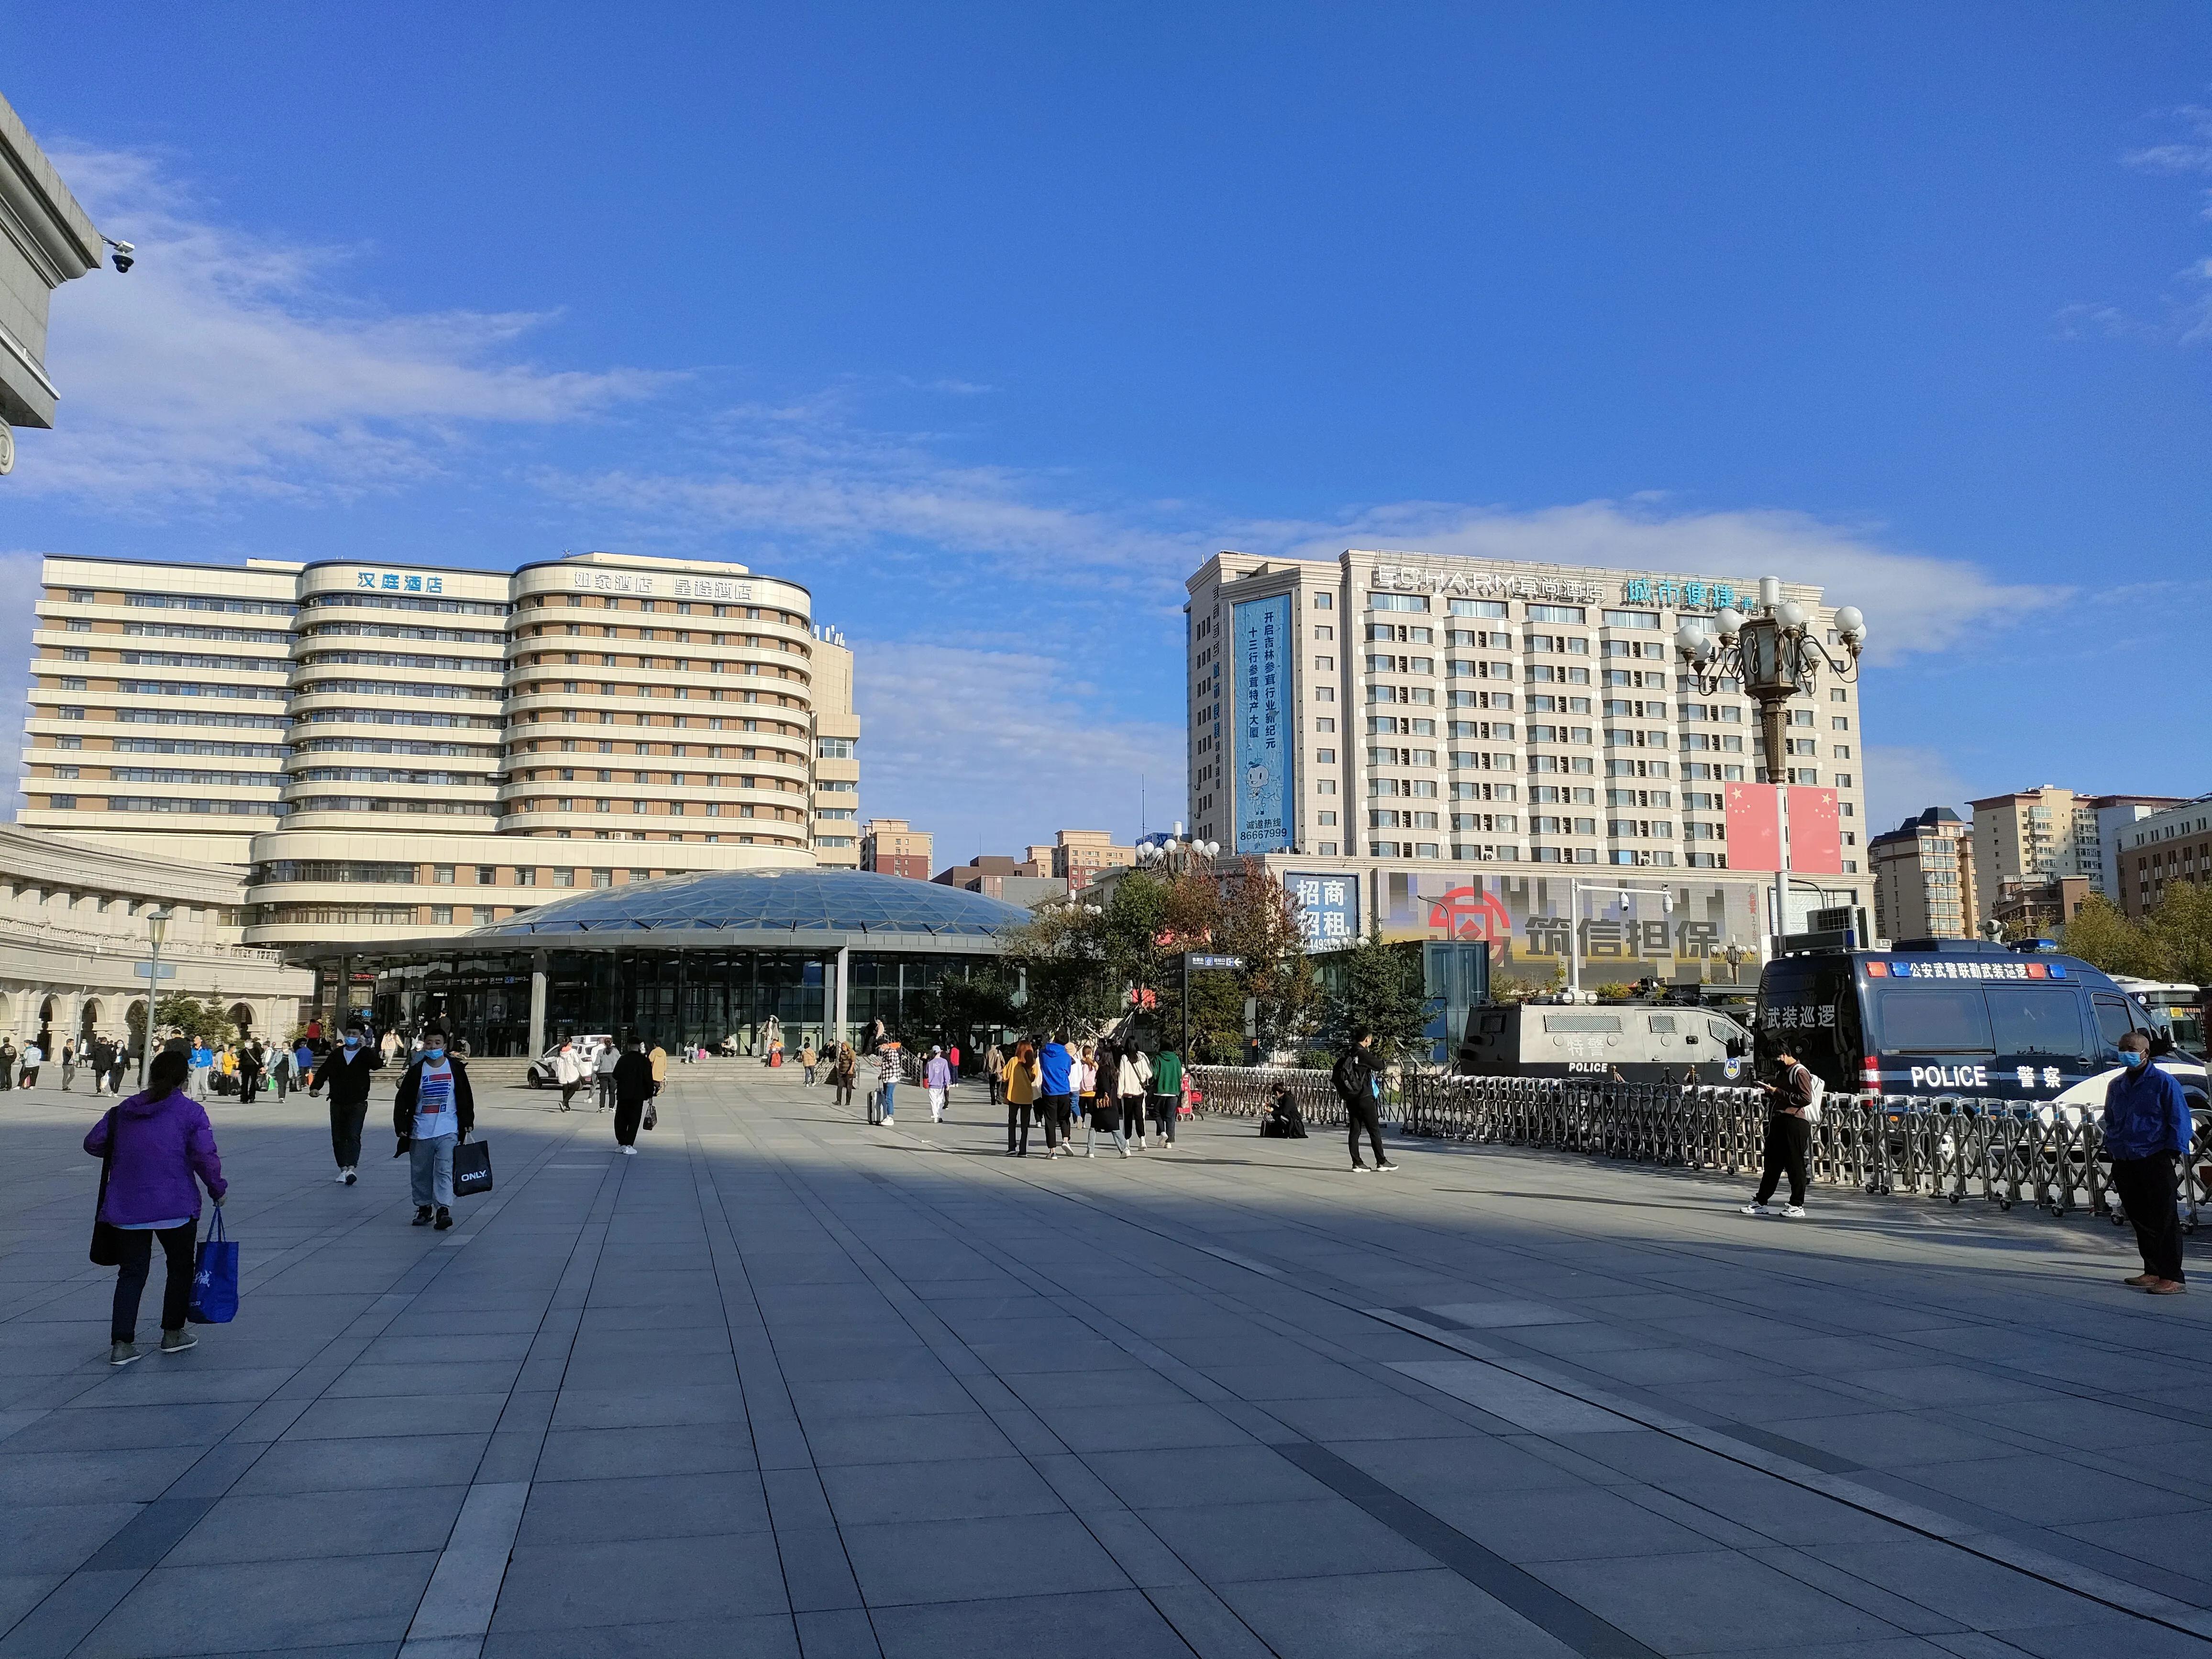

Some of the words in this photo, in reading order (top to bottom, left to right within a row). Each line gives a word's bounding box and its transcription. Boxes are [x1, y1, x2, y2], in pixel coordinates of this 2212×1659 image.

[358, 572, 442, 593] 汉庭酒店
[575, 573, 653, 593] 如家酒店
[1518, 575, 1604, 599] 宜尚酒店
[1248, 627, 1259, 738] 十三行参茸特产大厦
[1264, 611, 1276, 750] 开启吉林参茸行业新纪元
[1240, 828, 1287, 841] 86667999
[1246, 818, 1281, 830] 诚邀热线
[1296, 879, 1345, 906] 招商
[1297, 909, 1347, 936] 招租
[1525, 917, 1720, 959] 筑信担保
[1910, 962, 2029, 979] 公安武警联勤武装巡逻
[1767, 1005, 1835, 1029] 武装巡逻
[1567, 1037, 1605, 1057] 特警
[1569, 1062, 1608, 1073] POLICE
[1911, 1066, 1988, 1087] POLICE
[2016, 1066, 2061, 1088] 警察
